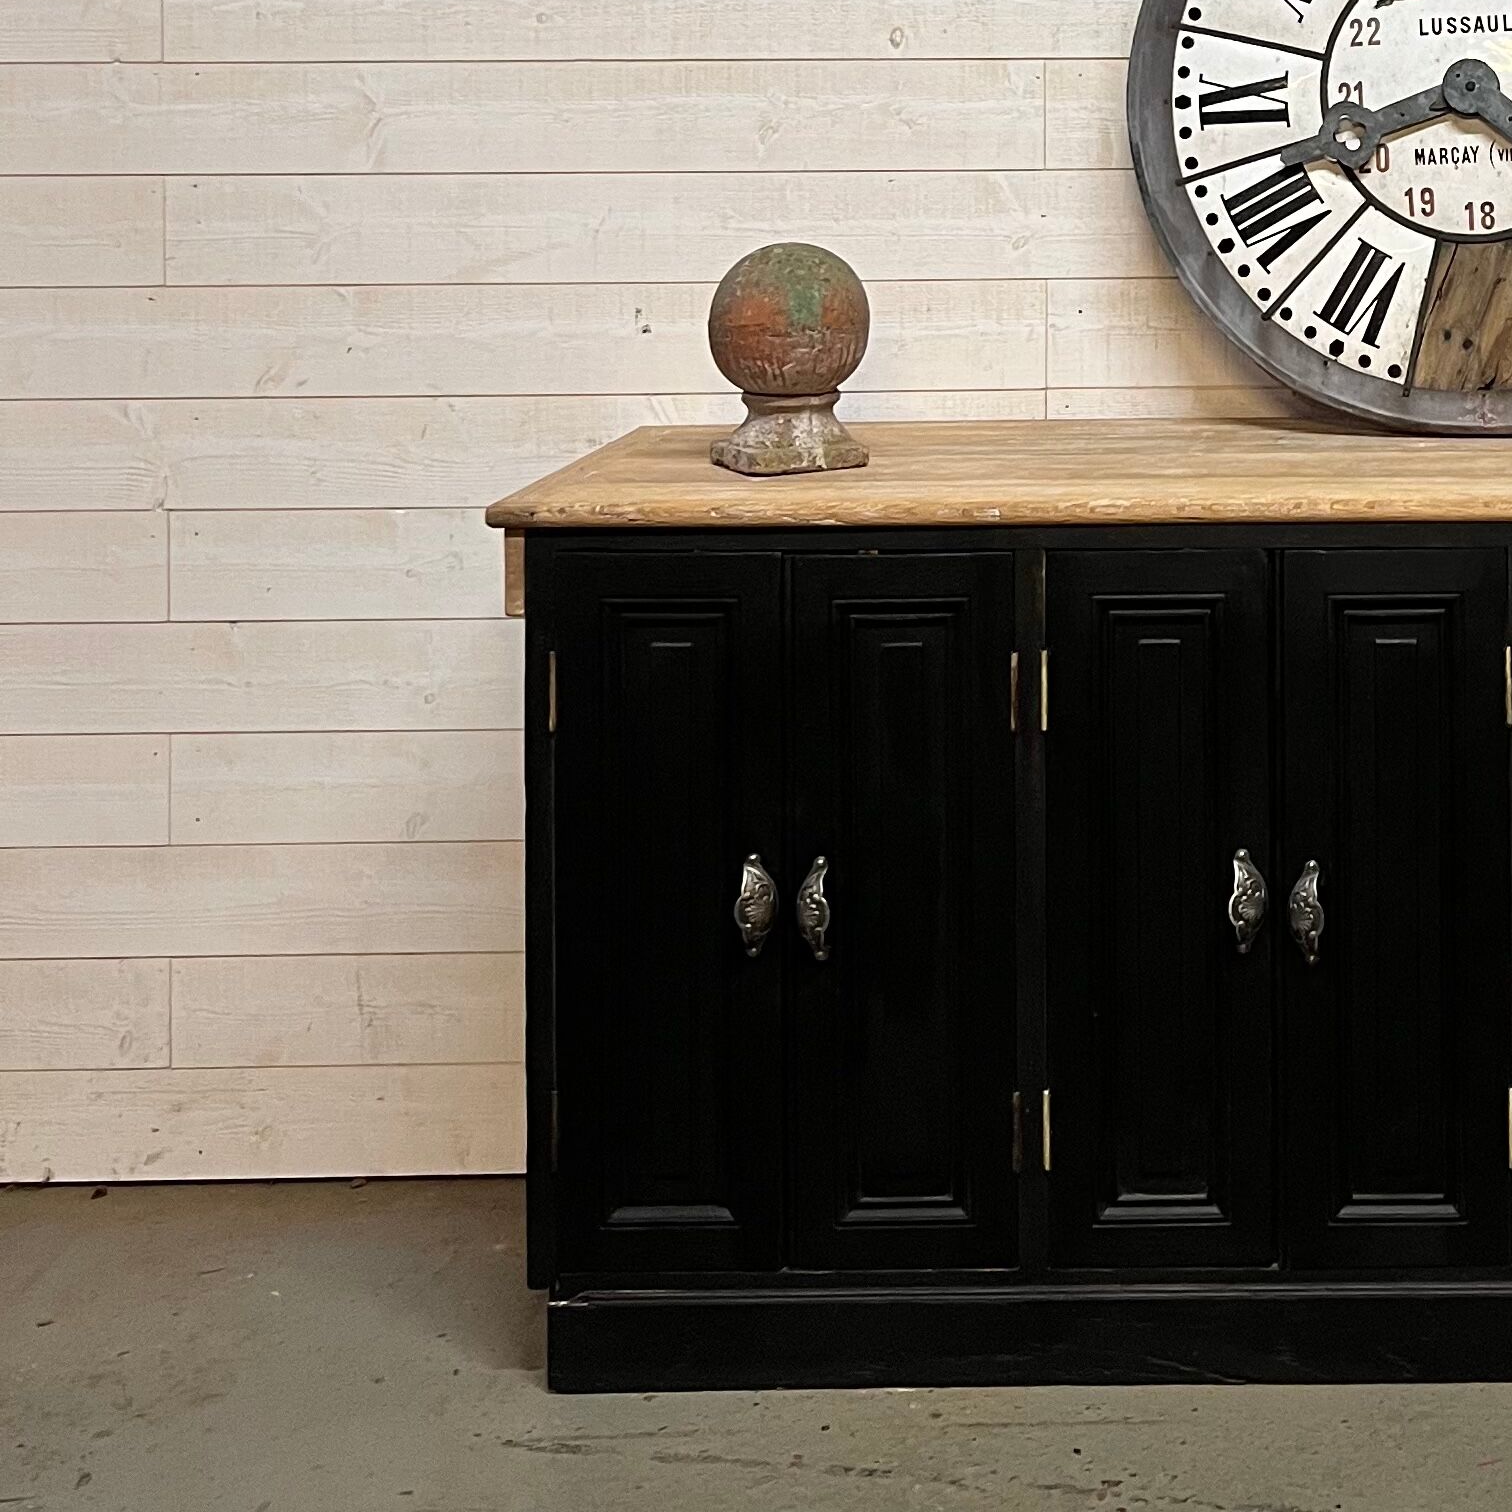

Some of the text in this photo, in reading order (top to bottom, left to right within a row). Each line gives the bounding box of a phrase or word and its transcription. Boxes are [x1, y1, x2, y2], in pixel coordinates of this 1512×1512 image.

[1350, 17, 1382, 47] 22
[1199, 70, 1290, 131] IX
[1414, 145, 1479, 170] MARÇAY
[1404, 187, 1435, 217] 19
[1464, 201, 1496, 231] 18
[1221, 162, 1332, 275] VIII
[1313, 237, 1406, 349] VII
